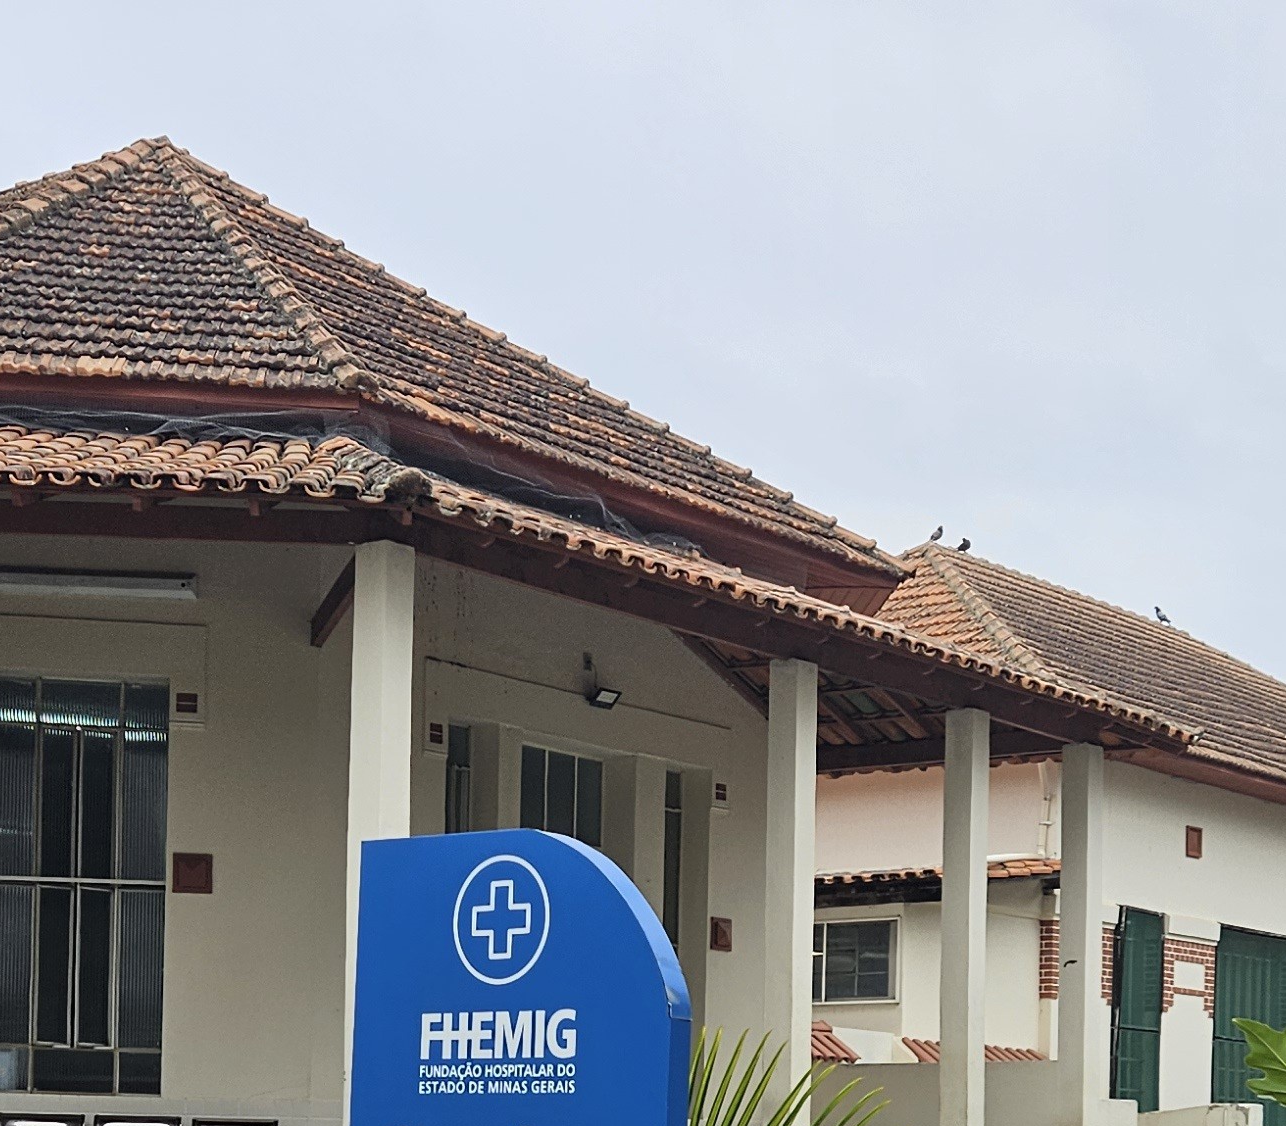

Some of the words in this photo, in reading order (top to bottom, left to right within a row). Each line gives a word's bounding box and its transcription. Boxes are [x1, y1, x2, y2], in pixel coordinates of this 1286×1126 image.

[420, 1008, 577, 1060] FHEMIG
[419, 1062, 482, 1081] FUNDAÇÃO
[484, 1063, 555, 1078] HOSPITALAR
[557, 1063, 576, 1078] DO
[418, 1080, 466, 1095] ESTADO
[468, 1080, 485, 1095] DE
[487, 1079, 528, 1094] MINAS
[530, 1079, 576, 1094] GERAIS
